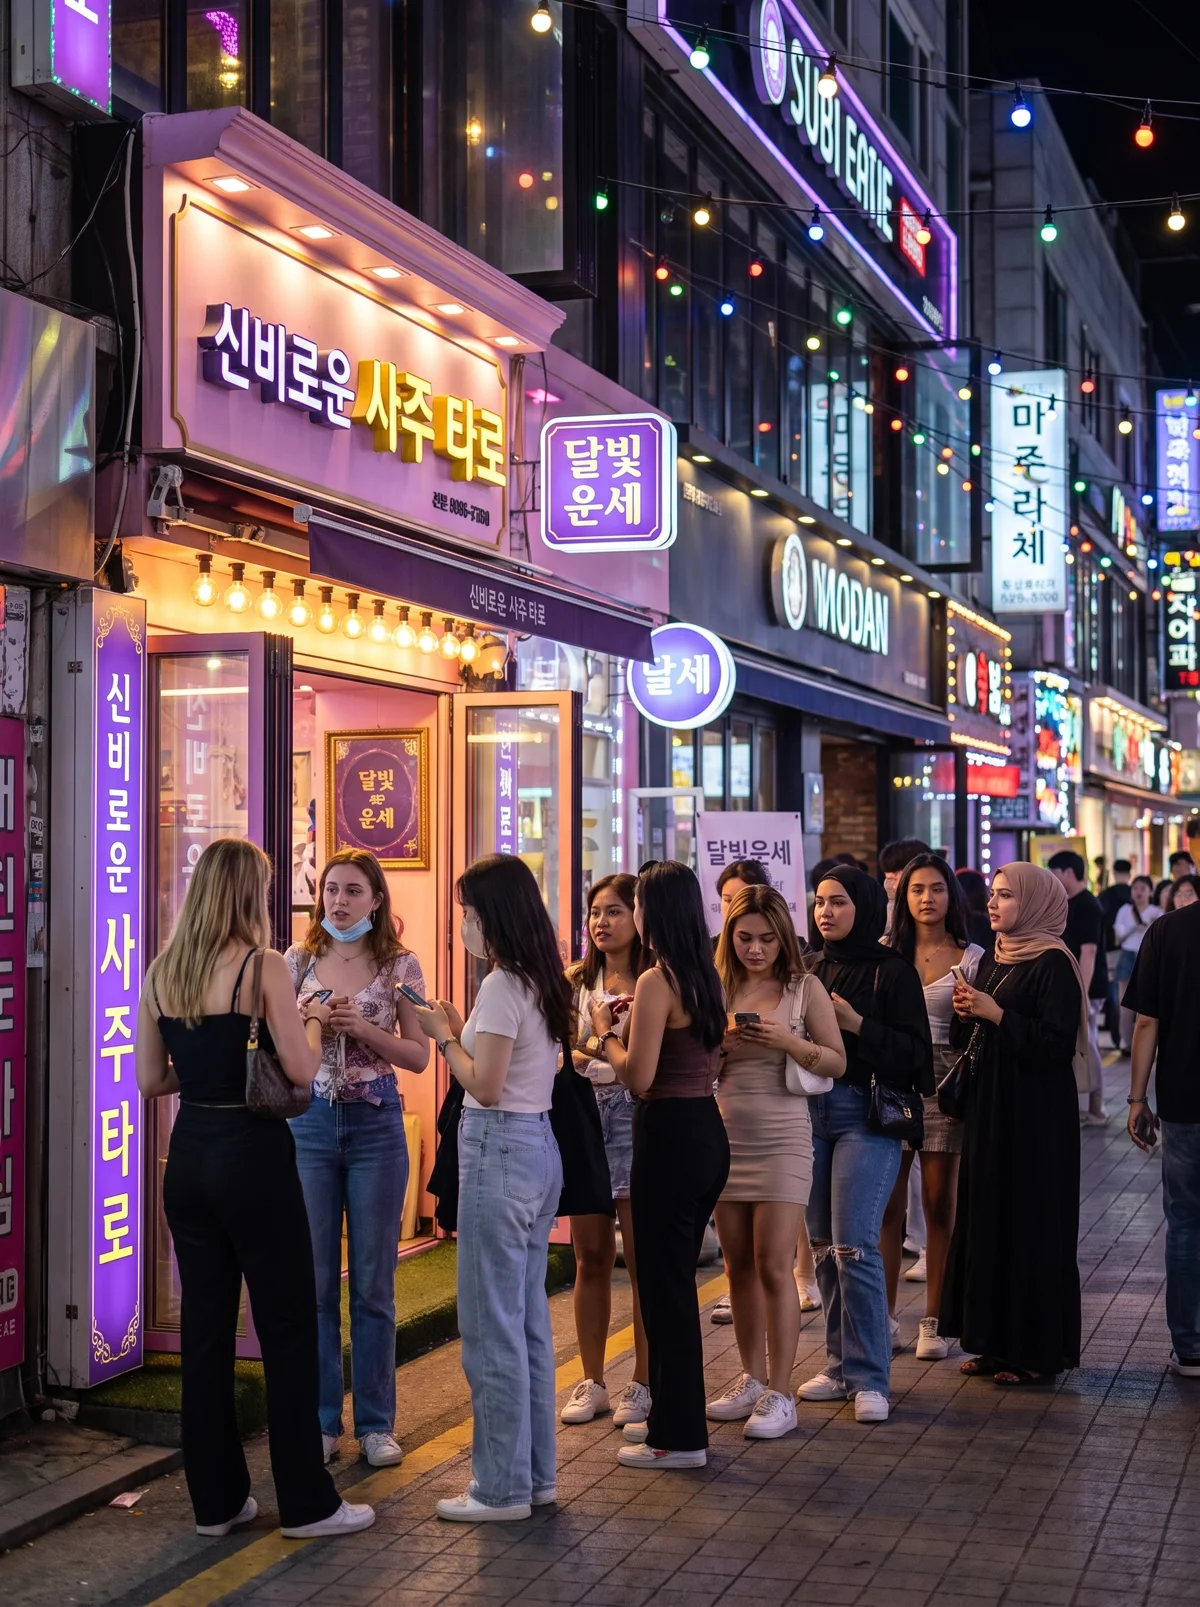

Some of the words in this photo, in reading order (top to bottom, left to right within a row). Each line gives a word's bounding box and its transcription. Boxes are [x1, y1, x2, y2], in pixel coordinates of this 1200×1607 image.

[208, 301, 356, 430] 신비로운
[359, 358, 435, 464] 사주
[442, 394, 507, 487] 타로
[563, 434, 642, 479] 달빛
[563, 482, 642, 527] 운세
[469, 584, 507, 618] 신비로운
[509, 595, 528, 623] 사주
[528, 601, 546, 626] 타로
[812, 558, 889, 656] MODAN
[106, 672, 131, 894] 신비로운
[359, 769, 394, 792] 달빛
[359, 807, 394, 829] 운세
[706, 839, 792, 867] 달빛운세
